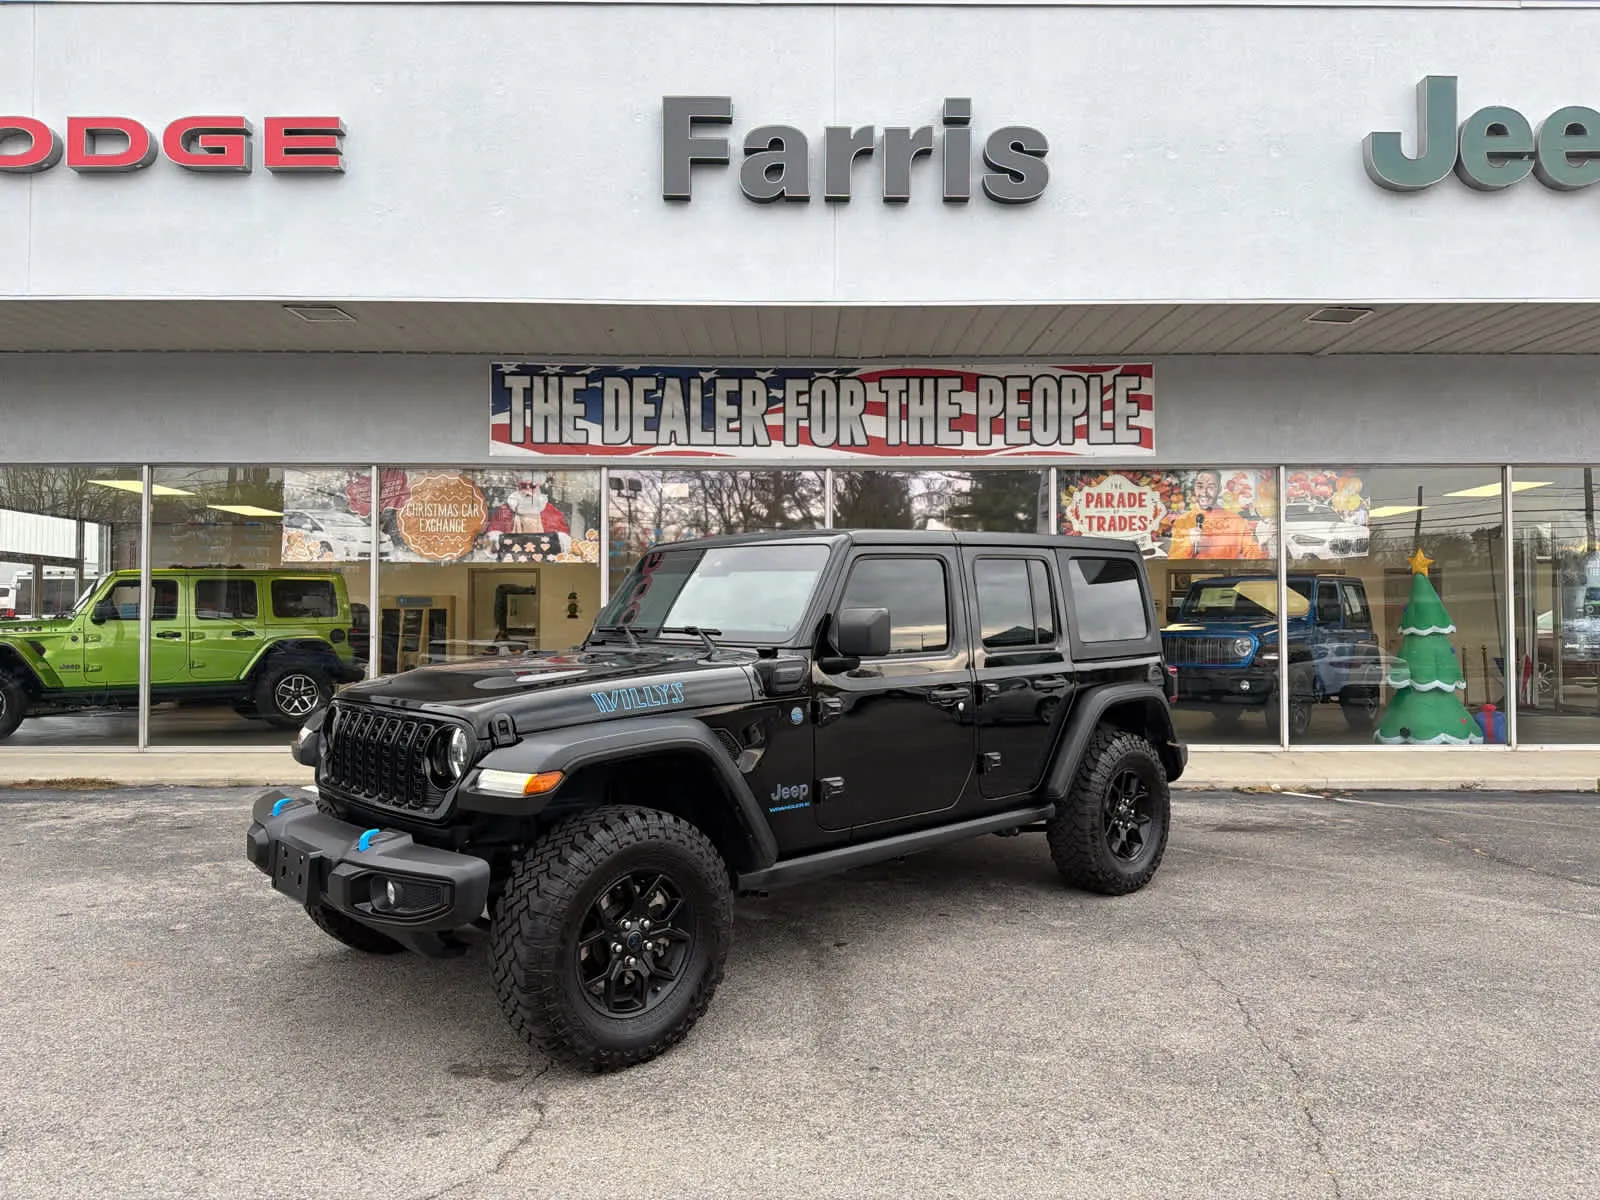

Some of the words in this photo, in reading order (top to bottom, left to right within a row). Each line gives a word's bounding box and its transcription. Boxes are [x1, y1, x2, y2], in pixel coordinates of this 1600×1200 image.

[0, 116, 345, 174] ODGE
[1362, 75, 1600, 192] Jee
[662, 95, 1050, 203] Farris
[504, 375, 589, 445] THE
[602, 375, 772, 447] DEALER
[784, 376, 869, 447] FOR
[879, 375, 964, 446] THE
[976, 374, 1142, 446] PEOPLE
[406, 503, 459, 518] CHRISTMAS
[461, 503, 480, 518] CAR
[1085, 491, 1148, 509] PARADE
[419, 519, 467, 533] EXCHANGE
[1084, 515, 1148, 532] TRADES
[590, 682, 685, 713] WILLYS
[770, 783, 809, 801] Jeep
